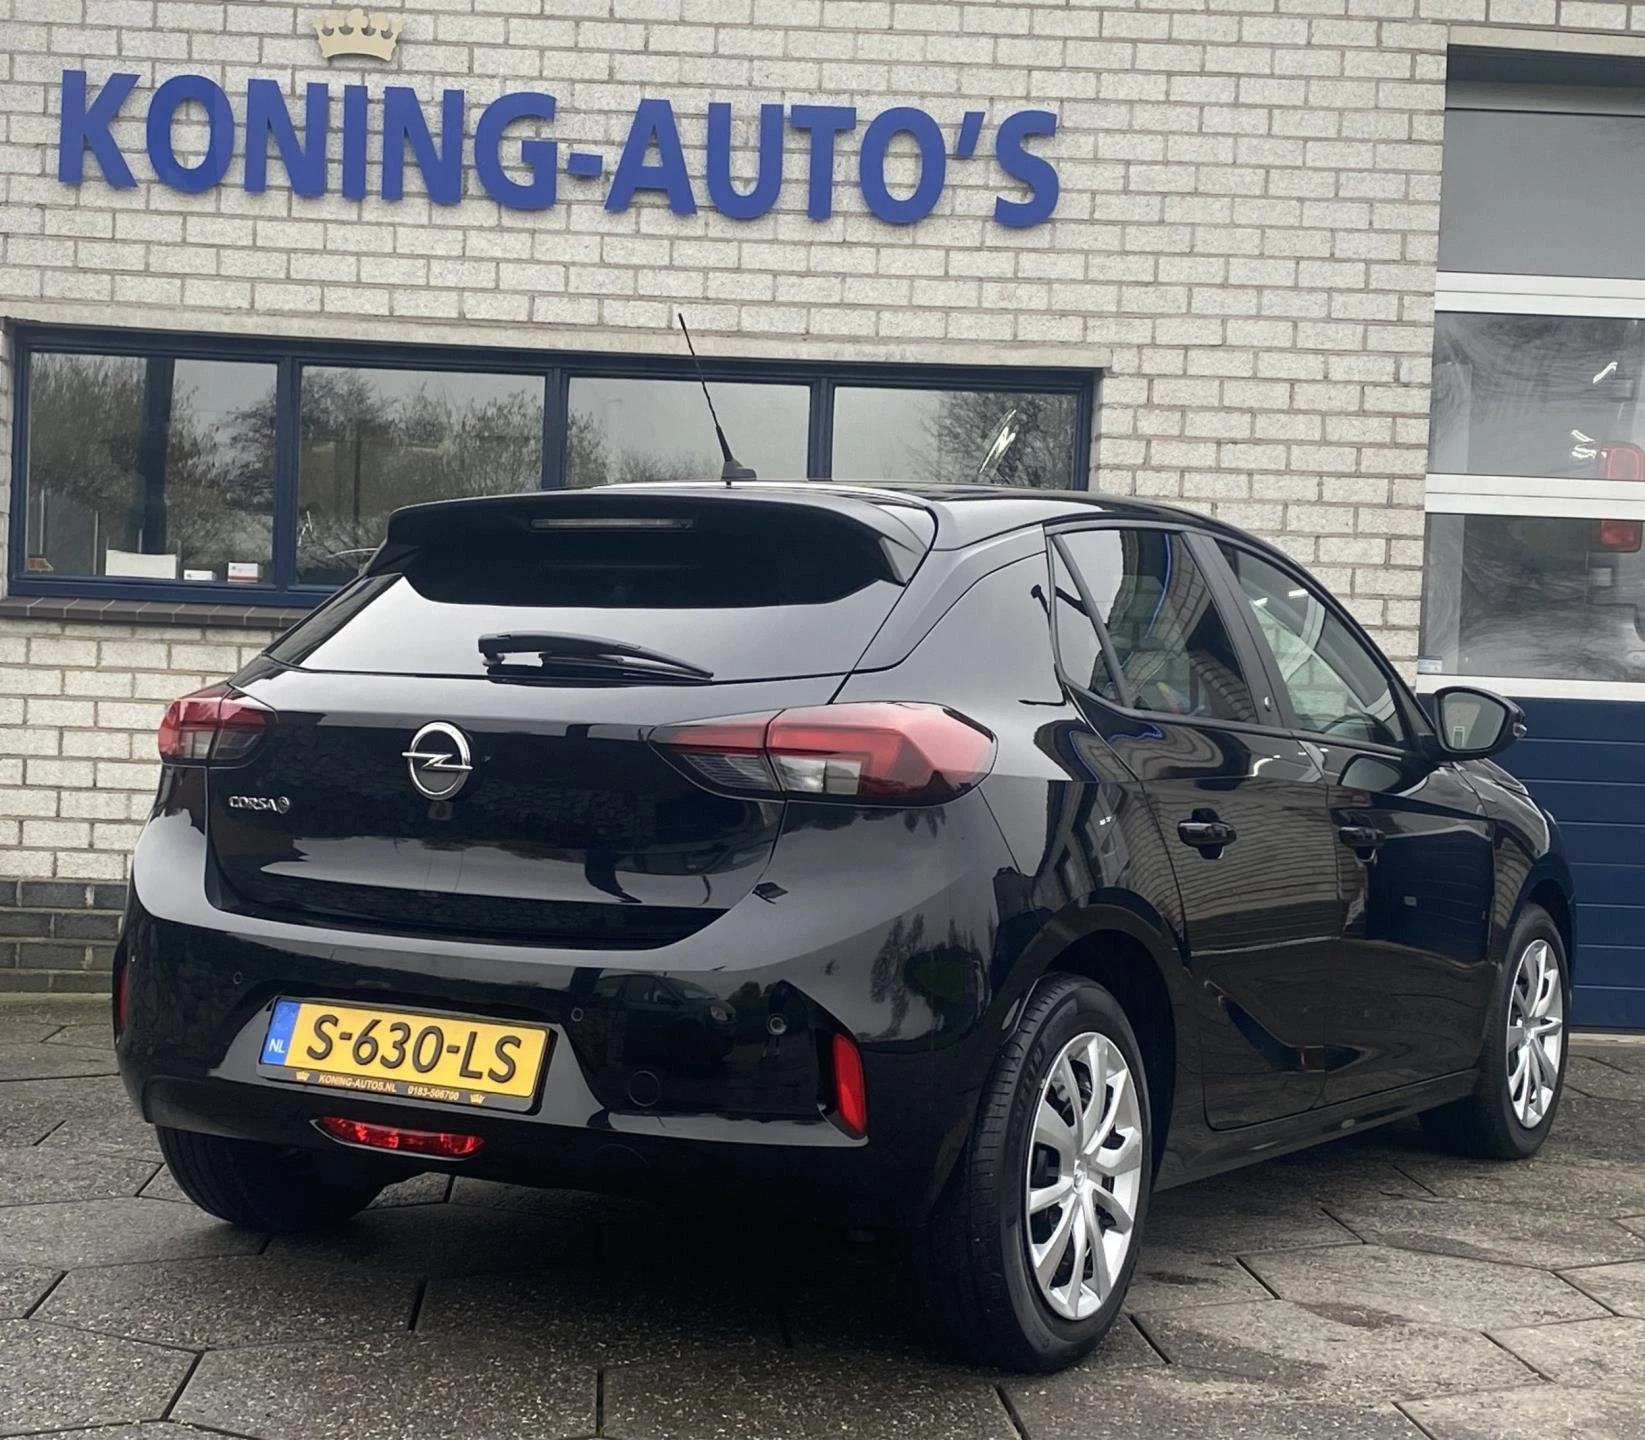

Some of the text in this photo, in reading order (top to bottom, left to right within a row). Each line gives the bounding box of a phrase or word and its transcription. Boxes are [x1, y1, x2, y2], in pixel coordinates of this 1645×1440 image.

[58, 69, 1060, 228] KONING-AUTO'S
[269, 1038, 285, 1054] NL
[306, 1014, 522, 1083] S-630-LS
[318, 1074, 397, 1093] KONING-AUTOS.NL
